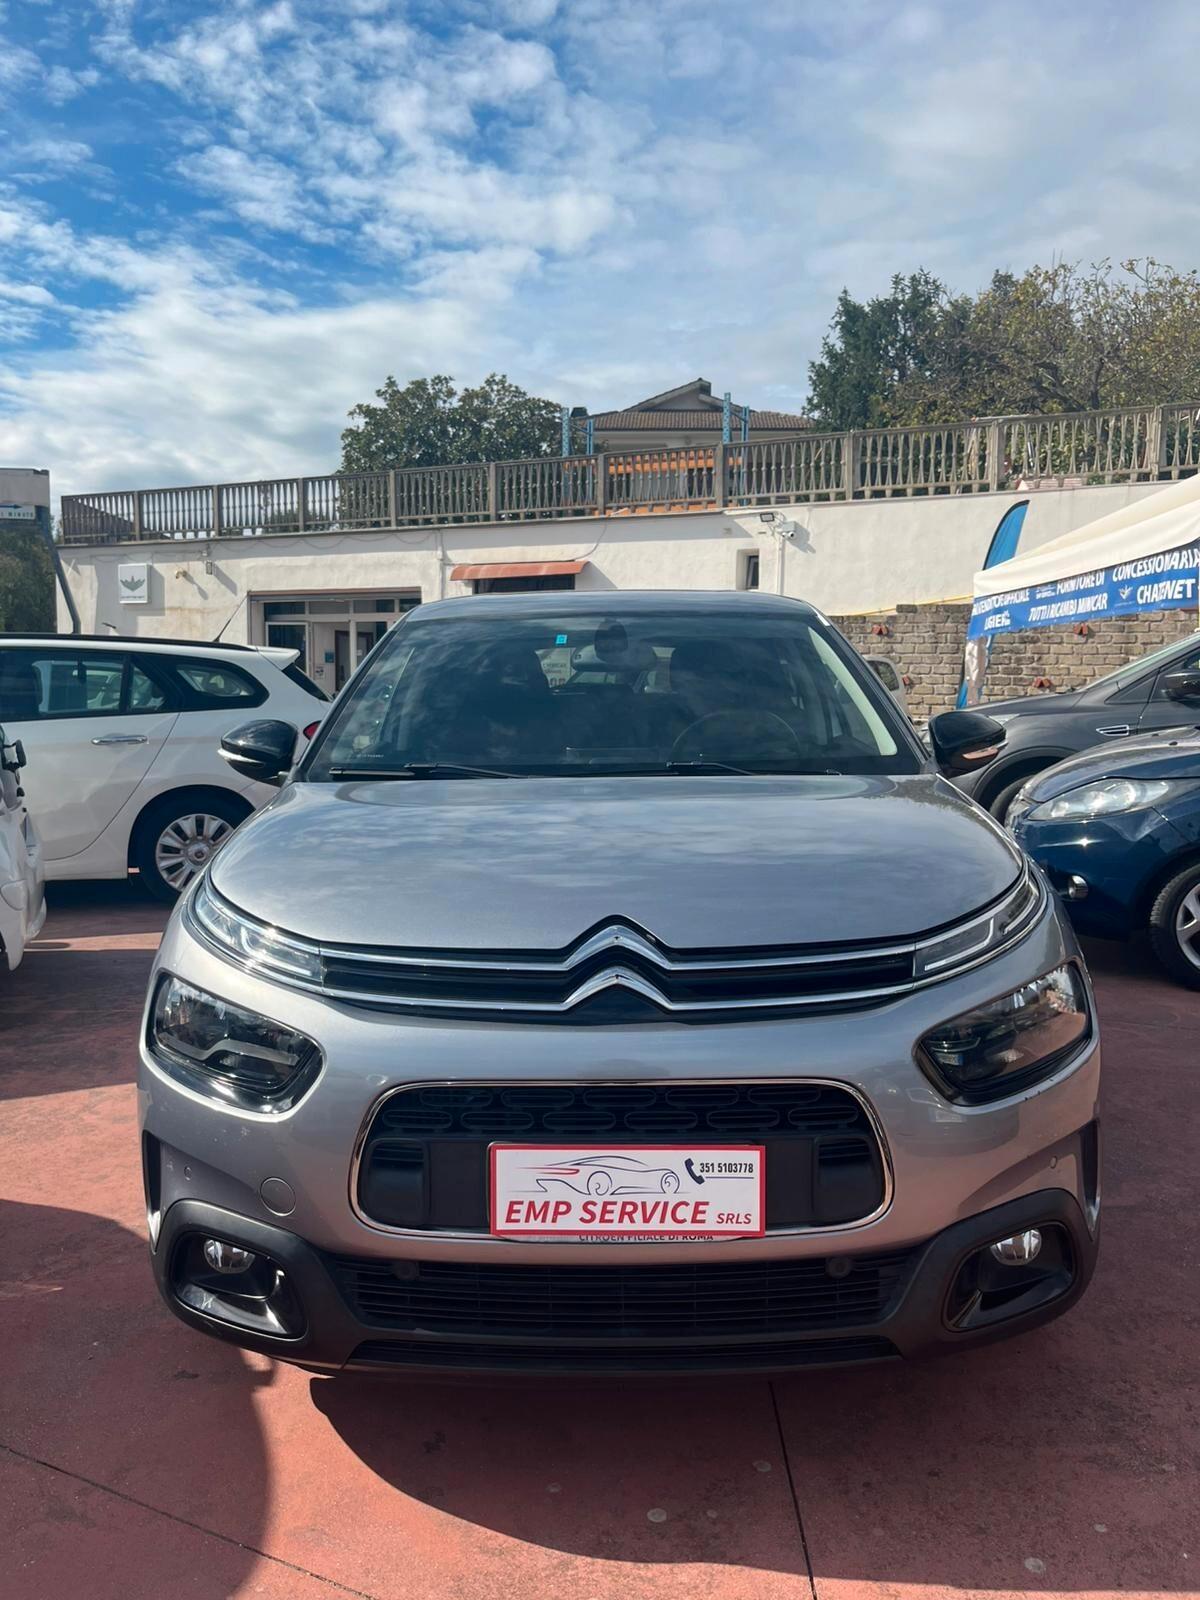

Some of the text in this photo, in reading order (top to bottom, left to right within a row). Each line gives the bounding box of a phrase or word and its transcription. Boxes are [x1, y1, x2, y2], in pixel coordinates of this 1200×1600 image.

[700, 1162, 754, 1174] 351 5103778
[505, 1200, 752, 1225] EMP SERVICE SRLS
